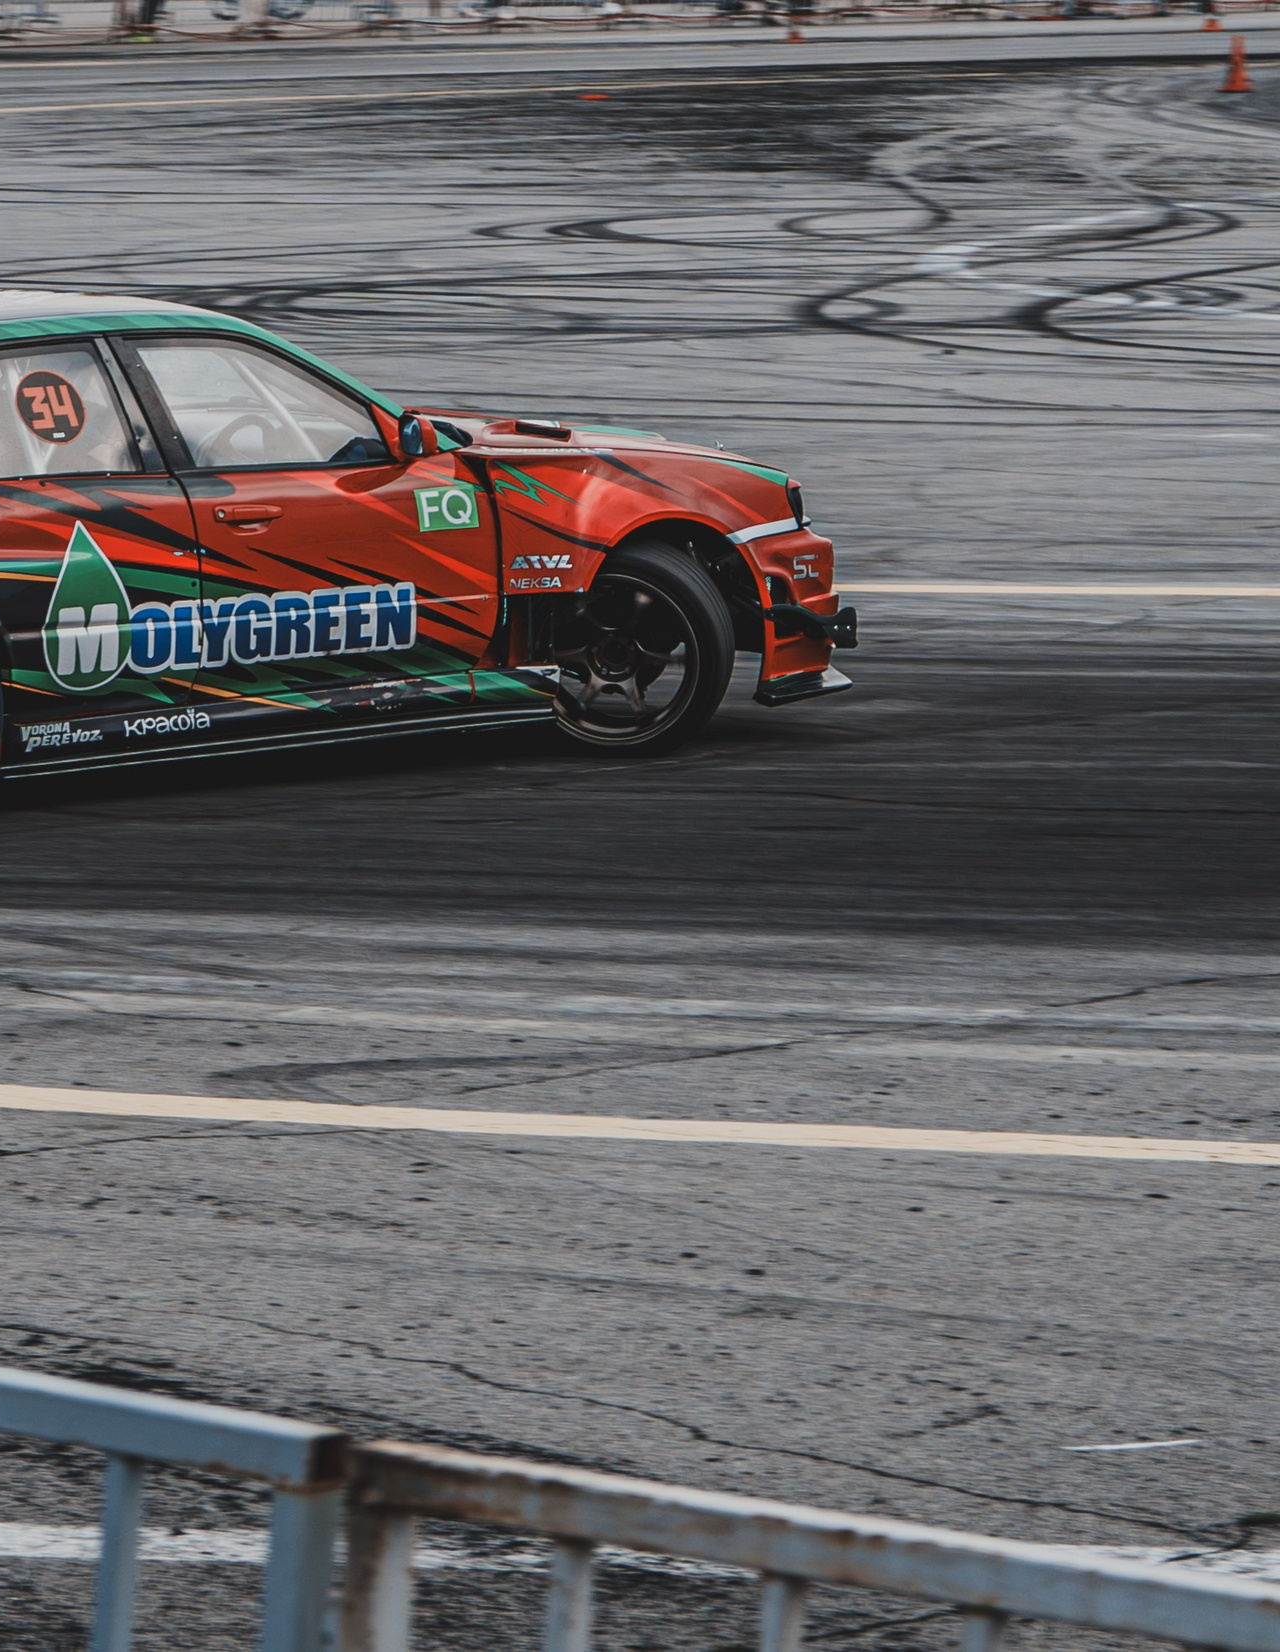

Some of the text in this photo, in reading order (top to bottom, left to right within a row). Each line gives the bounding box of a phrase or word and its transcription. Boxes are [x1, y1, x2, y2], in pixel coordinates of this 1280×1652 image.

[22, 384, 79, 429] 34
[419, 489, 473, 528] FQ
[509, 576, 562, 590] NEKSA
[56, 578, 417, 676] MOLYGREEN
[21, 722, 70, 742] VORONA
